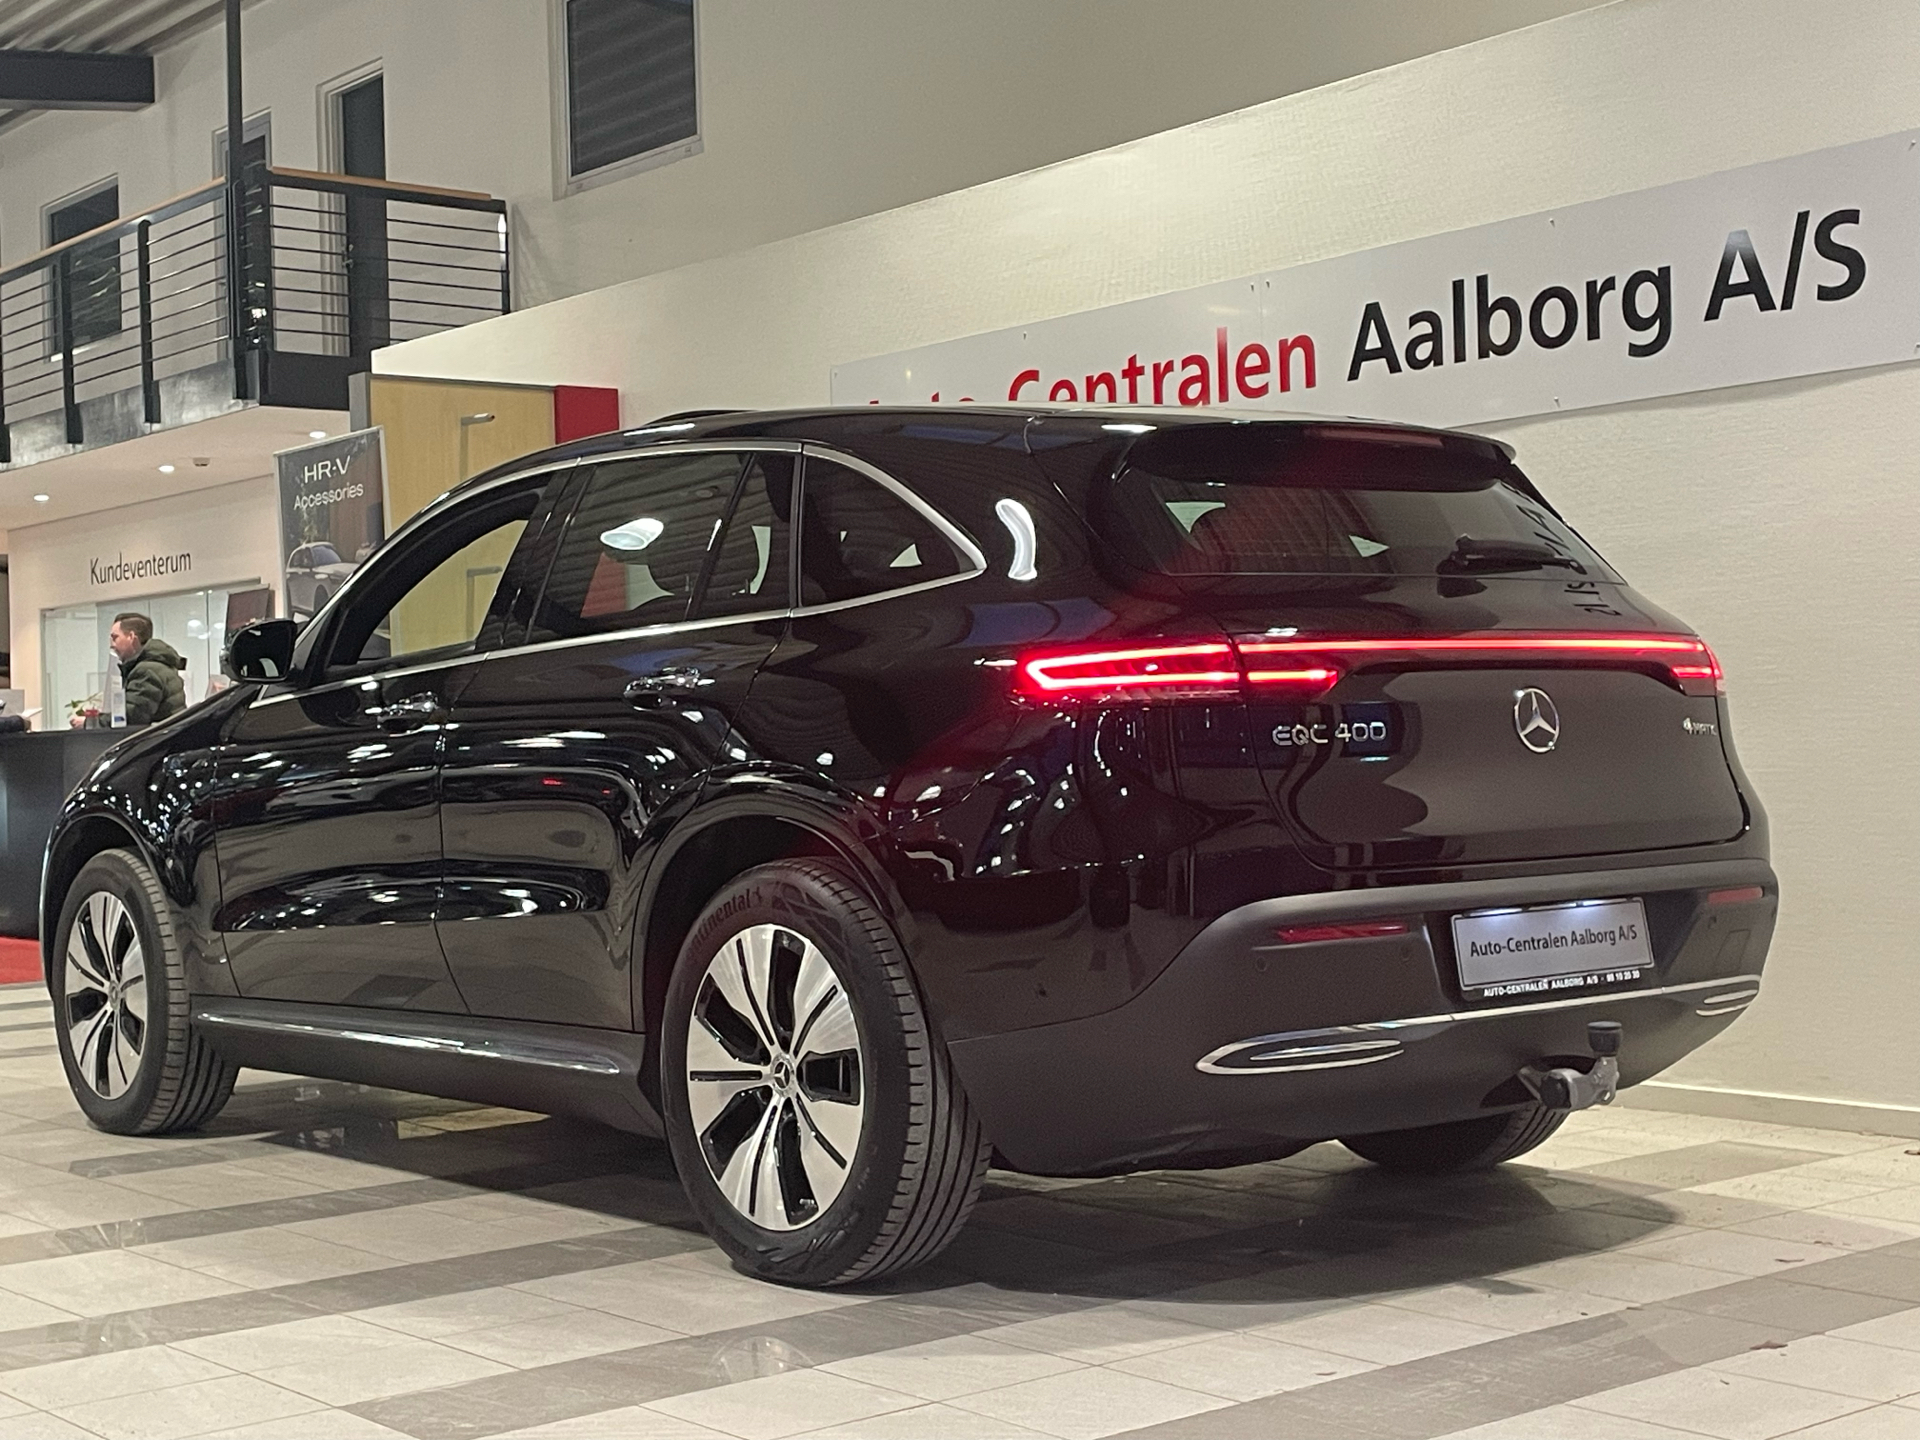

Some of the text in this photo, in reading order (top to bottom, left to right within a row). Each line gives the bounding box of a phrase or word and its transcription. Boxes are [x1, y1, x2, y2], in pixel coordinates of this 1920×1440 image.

[1345, 262, 1673, 384] Aalborg
[1703, 208, 1867, 323] A/S
[293, 482, 364, 510] Accessories
[90, 551, 192, 585] Kundeventerum
[1272, 721, 1387, 746] EQC 400
[1470, 924, 1638, 957] Auto-Centralen Aalborg A/S
[1551, 976, 1585, 989] AALBORG
